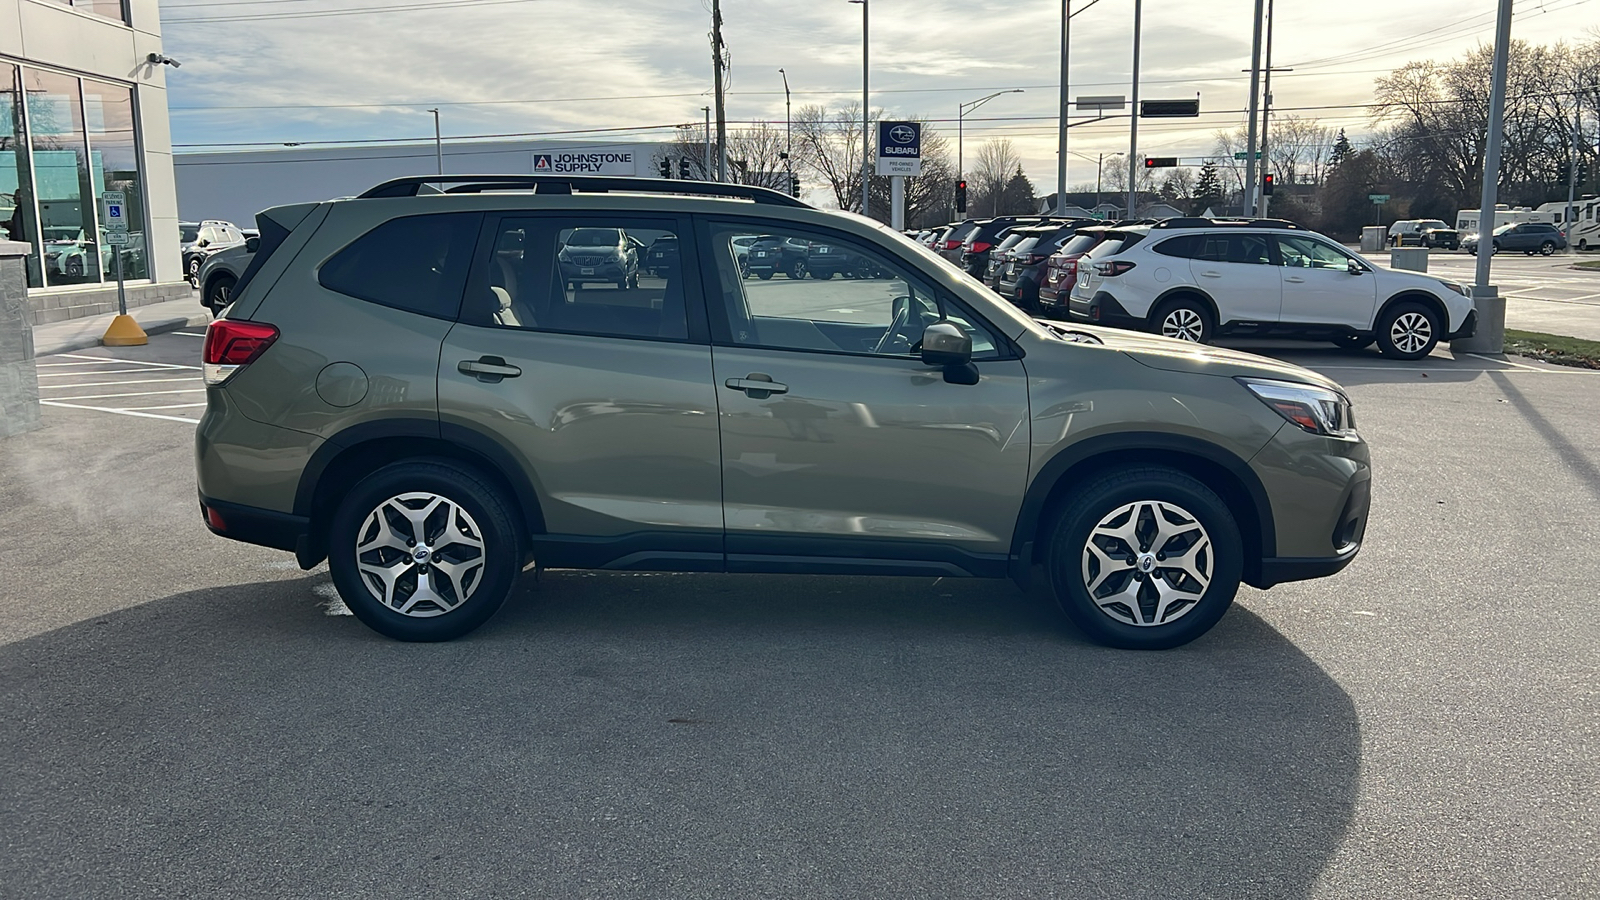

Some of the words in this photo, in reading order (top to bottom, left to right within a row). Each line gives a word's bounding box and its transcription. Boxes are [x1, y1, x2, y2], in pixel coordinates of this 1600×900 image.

[885, 146, 918, 155] SUBARU
[554, 153, 632, 163] JOHNSTONE
[554, 163, 603, 172] SUPPLY
